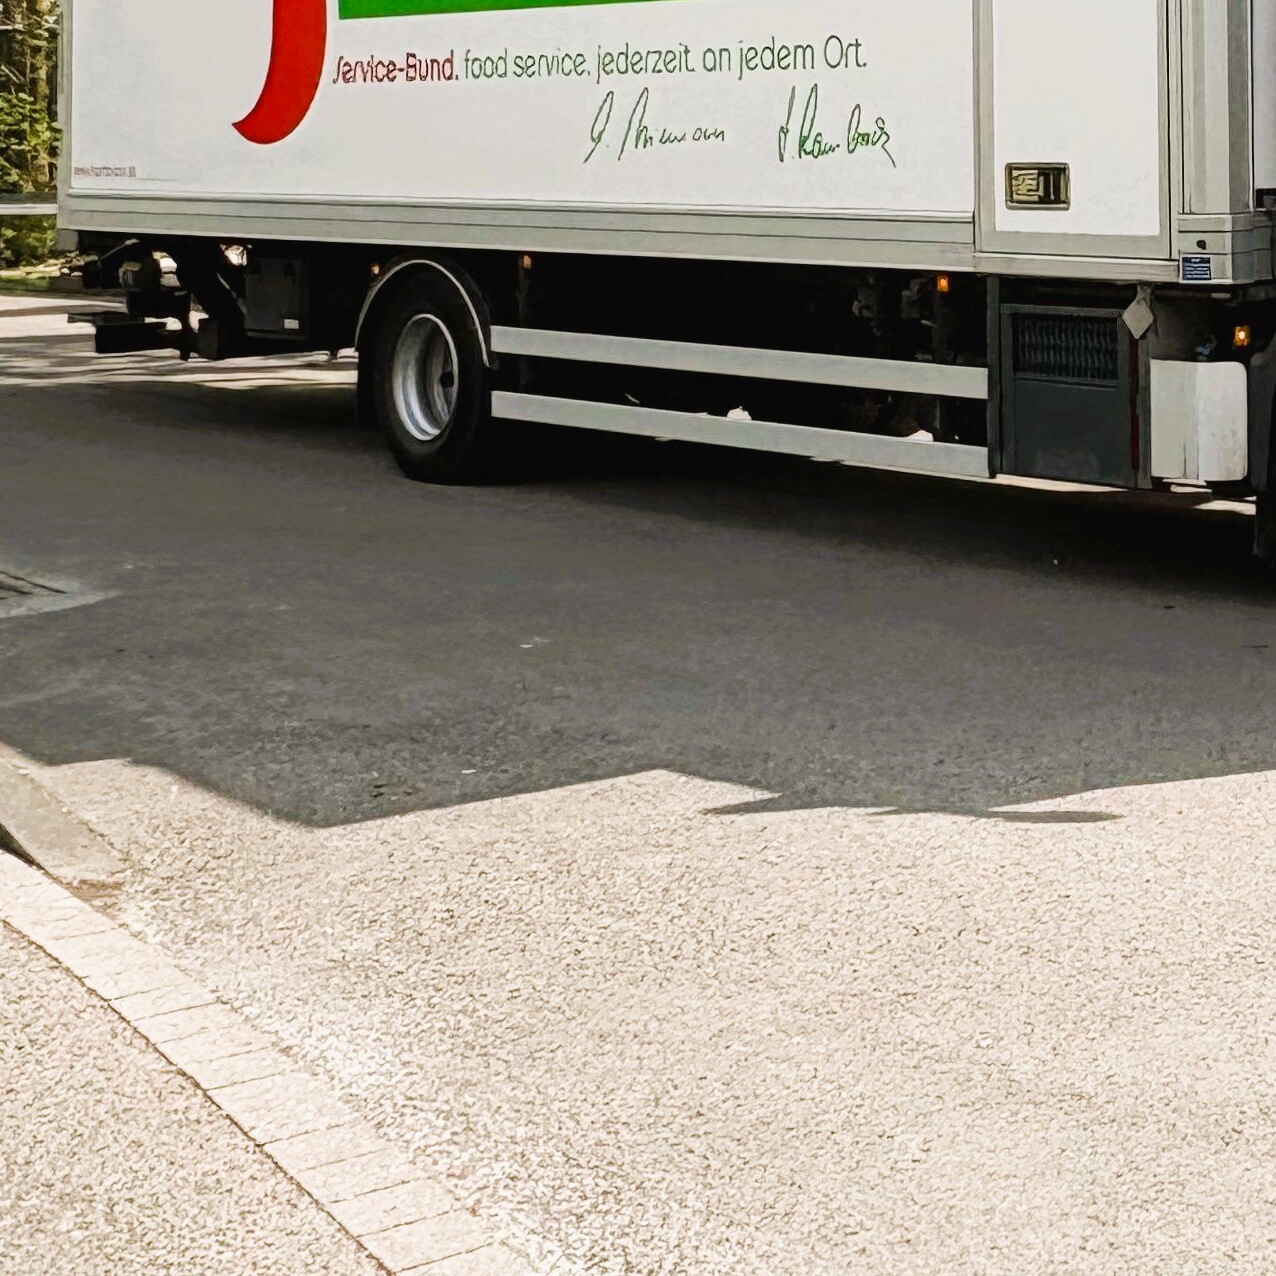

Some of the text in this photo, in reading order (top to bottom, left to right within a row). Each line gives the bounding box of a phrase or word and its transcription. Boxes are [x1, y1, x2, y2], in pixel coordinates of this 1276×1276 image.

[464, 47, 508, 80] food
[702, 47, 732, 73] an
[737, 36, 815, 81] jedem
